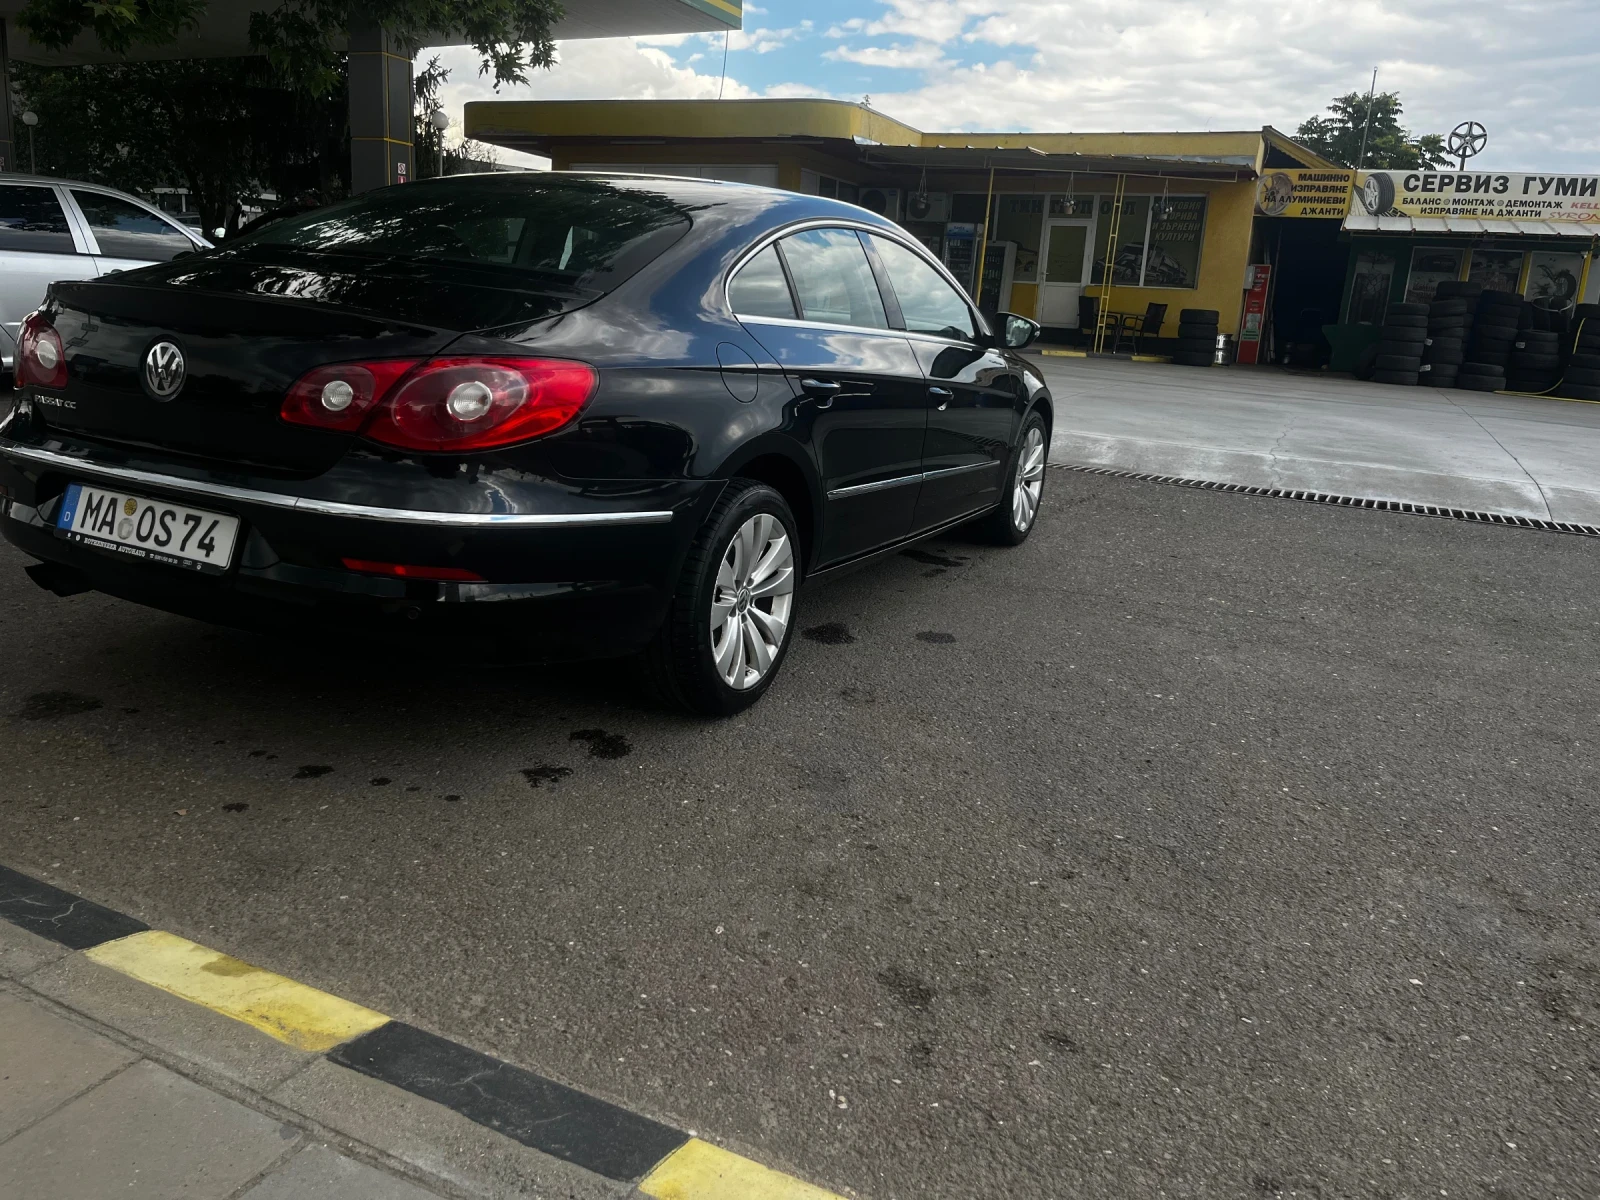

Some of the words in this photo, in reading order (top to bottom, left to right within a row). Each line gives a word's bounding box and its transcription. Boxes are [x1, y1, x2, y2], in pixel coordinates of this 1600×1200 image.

[1298, 173, 1350, 182] МАШИННО
[1291, 184, 1348, 194] ИЗПРАВЯНЕ
[1403, 173, 1509, 194] СЕРВИЗ
[1522, 176, 1598, 197] ГУМИ
[1264, 195, 1276, 203] НА
[1279, 195, 1346, 205] АЛУМИНИЕВИ
[1402, 197, 1442, 206] БАЛАНС
[1452, 198, 1495, 207] МОНТАЖ
[1505, 200, 1563, 209] ДЕМОНТАЖ
[1300, 207, 1344, 216] ДЖАНТИ
[1420, 207, 1478, 216] ИЗПРАВЯНЕ
[1481, 208, 1494, 216] НА
[1496, 209, 1542, 218] ДЖАНТИ
[64, 511, 71, 522] D
[80, 492, 119, 535] MA
